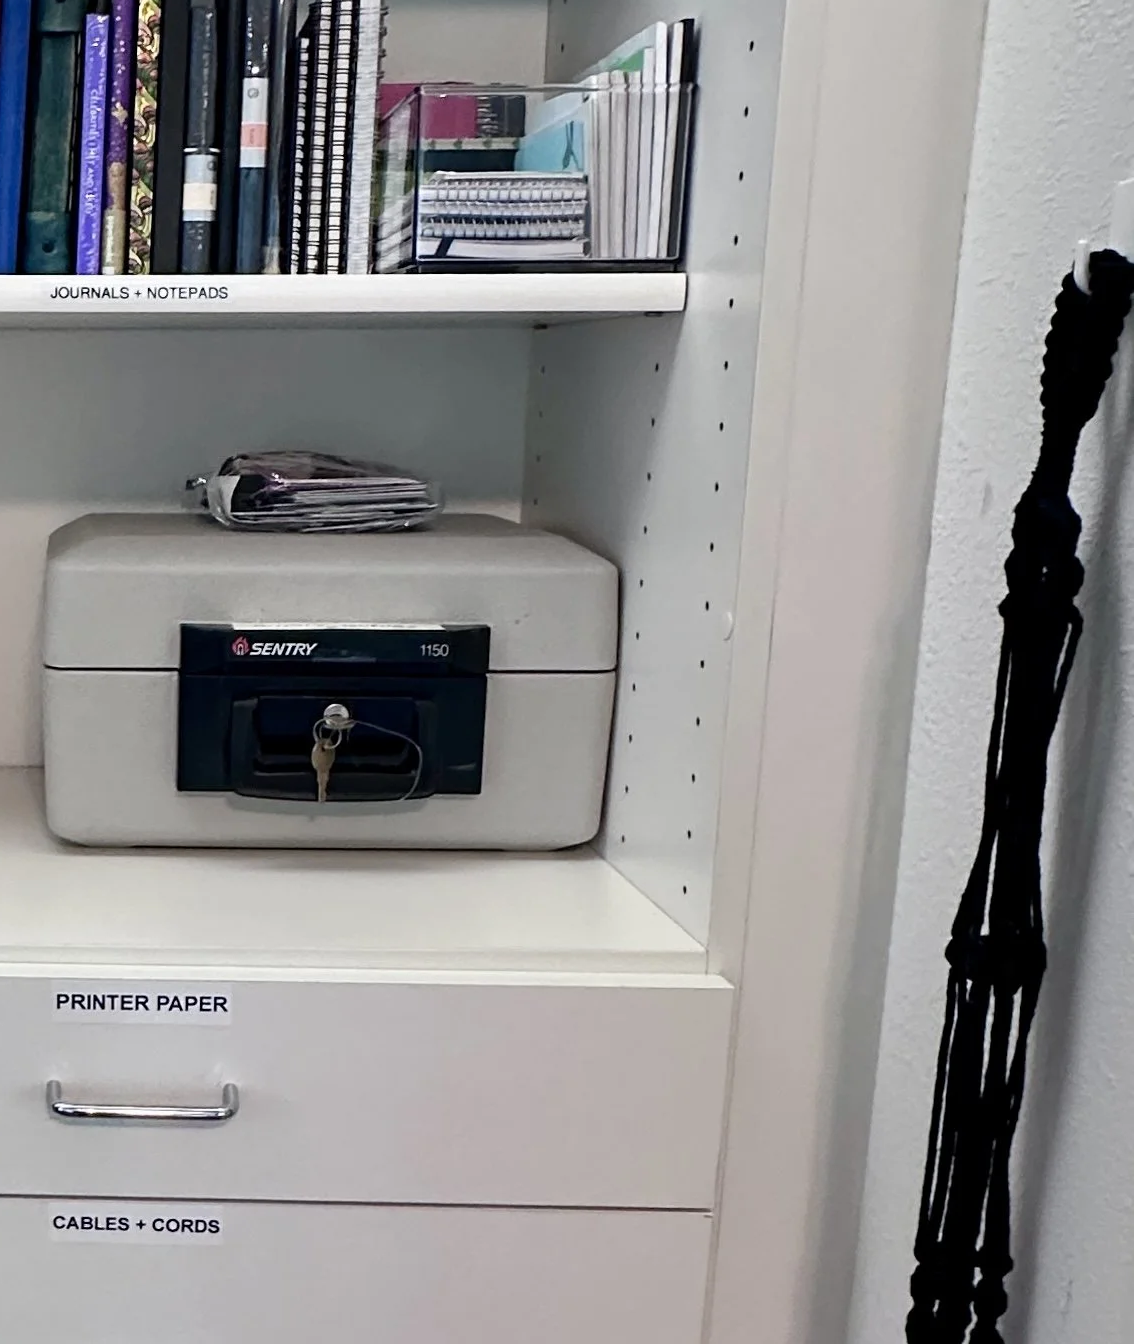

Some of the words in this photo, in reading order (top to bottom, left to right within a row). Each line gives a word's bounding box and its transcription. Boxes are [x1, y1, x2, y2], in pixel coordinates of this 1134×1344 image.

[49, 286, 130, 300] JOURNALS
[134, 288, 143, 298] +
[147, 286, 229, 301] NOTEPADS
[249, 642, 317, 656] SENTRY
[419, 644, 449, 656] 1150
[56, 993, 150, 1012] PRINTER
[156, 994, 228, 1013] PAPER
[52, 1215, 130, 1232] CABLES
[135, 1219, 147, 1230] +
[151, 1217, 221, 1234] CORDS
